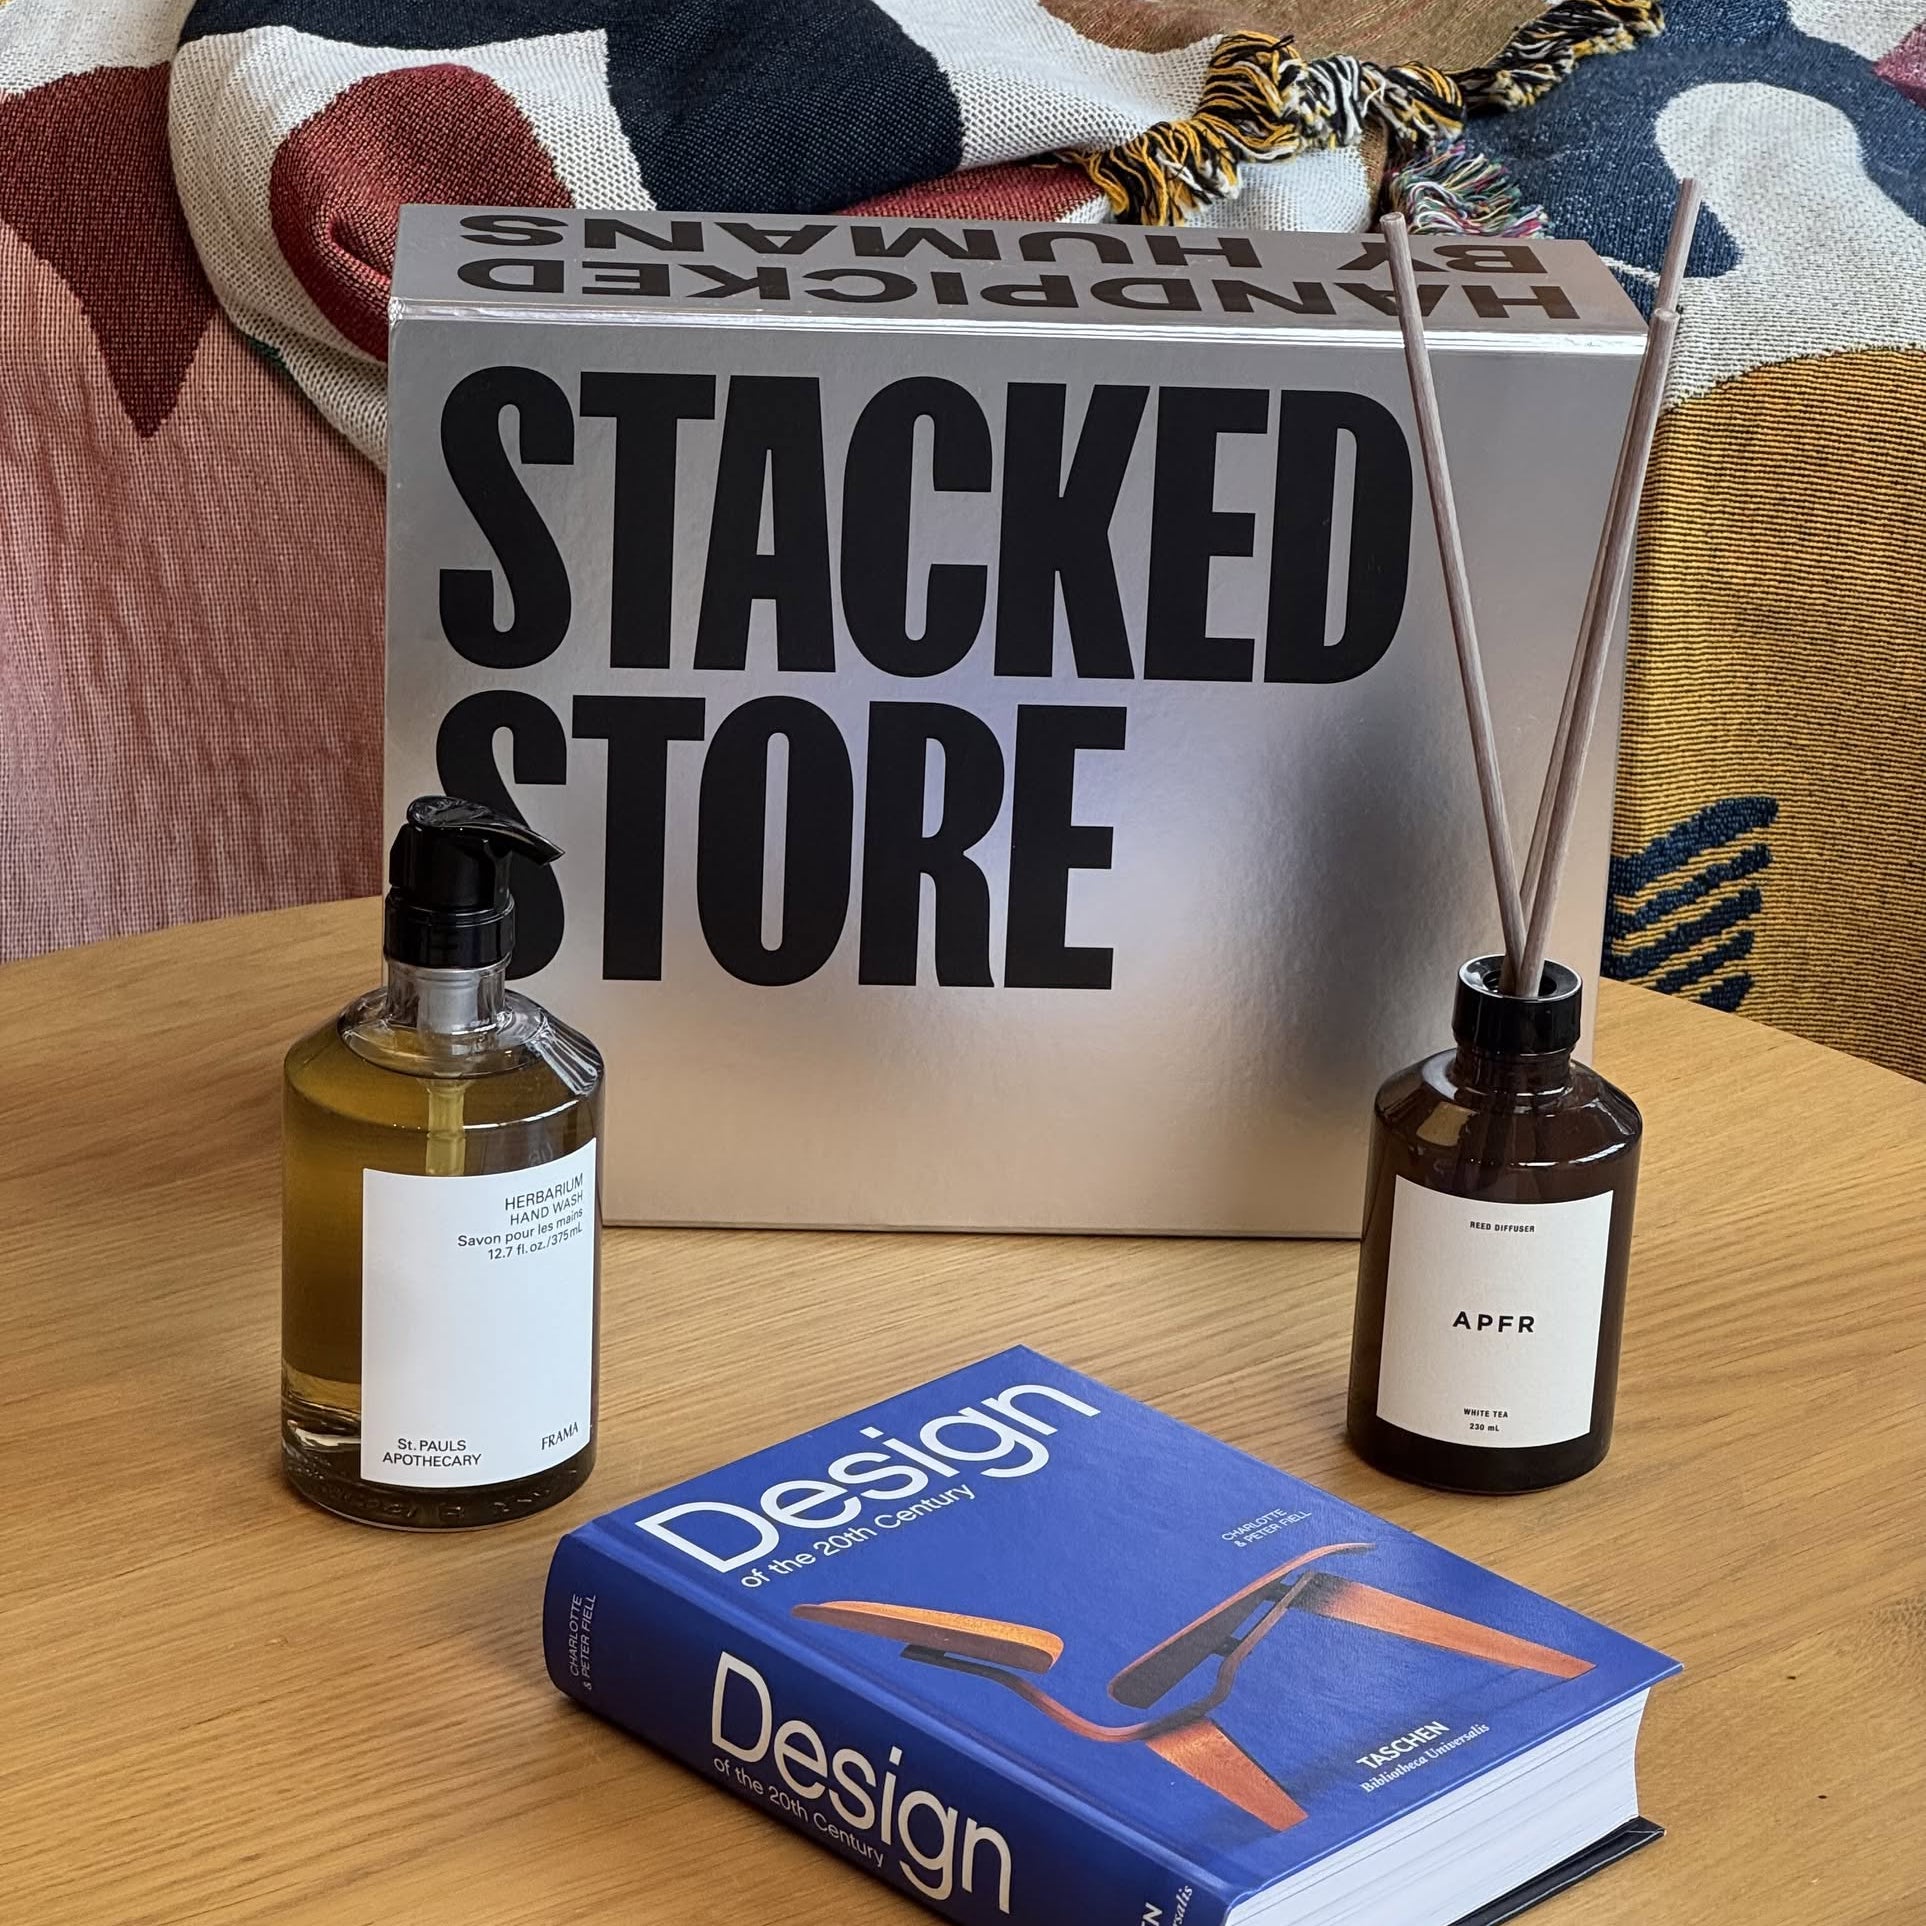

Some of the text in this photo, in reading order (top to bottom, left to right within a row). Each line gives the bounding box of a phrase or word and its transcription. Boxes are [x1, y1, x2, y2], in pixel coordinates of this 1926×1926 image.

[460, 214, 1548, 274] BY HUMANS
[457, 258, 1580, 319] HANDPICKED
[439, 365, 1413, 684] STACKED
[436, 689, 1127, 989] STORE
[505, 1172, 583, 1211] HERBARIUM
[510, 1189, 583, 1226] HAND WASH
[457, 1208, 583, 1247] Savon pour les mains
[1470, 1221, 1535, 1233] REED DIFFUSER
[488, 1246, 513, 1260] 12.7
[1452, 1310, 1535, 1334] APFR
[1463, 1408, 1508, 1418] WHITE TEA
[1469, 1423, 1500, 1432] 230 mL
[397, 1438, 467, 1452] St. PAULS
[541, 1421, 579, 1450] FRAMA
[382, 1452, 482, 1467] APOTHECARY
[634, 1383, 1101, 1574] Design
[741, 1484, 975, 1588] of the 20th Century
[1221, 1508, 1287, 1541] CHARLOTTE
[1234, 1510, 1313, 1548] & PETER FIELL
[568, 1593, 583, 1677] CHARLOTTE
[580, 1594, 597, 1691] & PETER FIELL
[1355, 1720, 1450, 1769] TASCHEN
[1360, 1723, 1490, 1793] Bibliotheca Universalis
[712, 1651, 1012, 1915] Design
[714, 1757, 884, 1868] of the 20th Century
